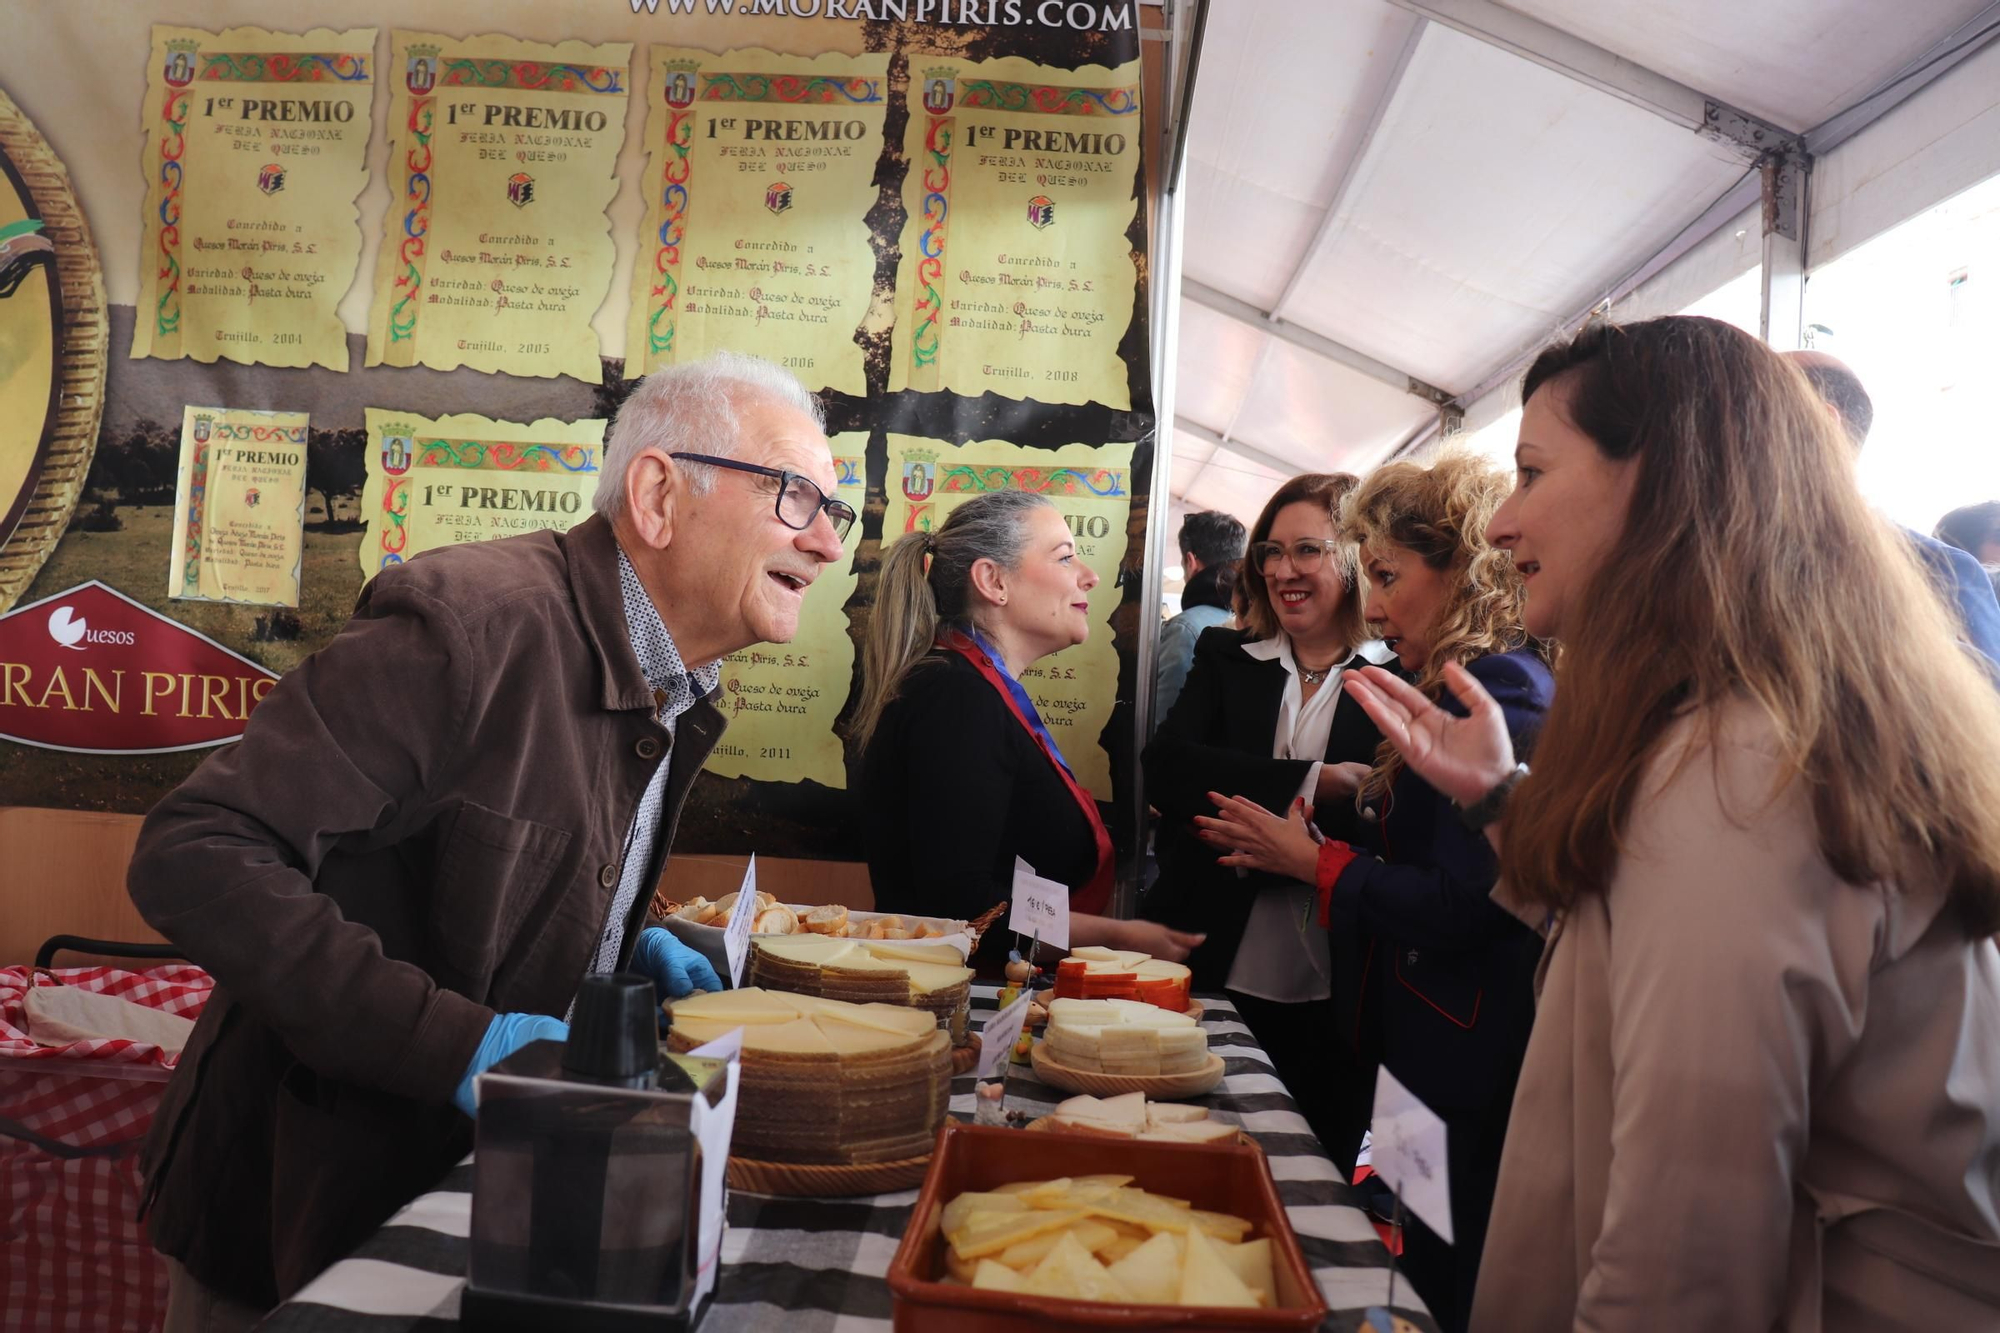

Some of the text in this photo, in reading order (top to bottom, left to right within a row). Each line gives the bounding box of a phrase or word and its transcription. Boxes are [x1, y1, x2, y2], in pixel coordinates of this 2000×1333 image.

[630, 0, 1133, 31] WWW.MORANPIRIS.COM
[241, 100, 354, 123] PREMIO
[484, 104, 607, 132] PREMIO
[744, 119, 866, 141] PREMIO
[271, 144, 320, 156] QUESO
[1003, 128, 1126, 155] PREMIO
[516, 151, 566, 163] QUESO
[776, 162, 826, 174] QUESO
[1037, 174, 1087, 187] QUESO
[227, 219, 286, 232] Concedido
[193, 237, 225, 251] Quesos
[228, 238, 260, 250] Morán
[479, 233, 538, 245] Concedido
[734, 239, 797, 253] Concedido
[441, 250, 475, 264] Quesos
[479, 252, 512, 266] Morán
[696, 256, 731, 271] Quesos
[735, 258, 769, 272] Morán
[998, 254, 1060, 268] Concedido
[241, 267, 276, 282] Queso
[278, 270, 291, 281] de
[293, 274, 325, 287] oveja
[959, 270, 995, 284] Quesos
[998, 273, 1033, 287] Morán
[248, 285, 282, 305] Pasta
[285, 287, 312, 299] dura
[491, 279, 528, 294] Queso
[532, 284, 544, 295] de
[548, 285, 579, 300] oveja
[494, 296, 534, 316] Pasta
[537, 299, 566, 312] dura
[750, 287, 787, 303] Queso
[791, 292, 804, 304] de
[809, 295, 841, 311] oveja
[755, 305, 794, 327] Pasta
[798, 309, 827, 323] dura
[1013, 302, 1050, 317] Queso
[1054, 307, 1067, 319] de
[1071, 310, 1104, 325] oveja
[1019, 319, 1057, 340] Pasta
[1062, 324, 1091, 338] dura
[273, 334, 302, 344] 2004
[518, 343, 550, 354] 2005
[782, 357, 814, 368] 2006
[1045, 370, 1078, 382] 2008
[236, 451, 299, 466] PREMIO
[460, 486, 582, 513] PREMIO
[749, 652, 779, 669] Piris,
[0, 662, 125, 713] RAN
[727, 679, 820, 702] Queso de oveja
[733, 697, 772, 718] Pasta
[776, 702, 806, 713] dura
[1036, 695, 1087, 714] de oveja
[1044, 713, 1073, 726] dura
[712, 745, 791, 759] ujillo, 2011
